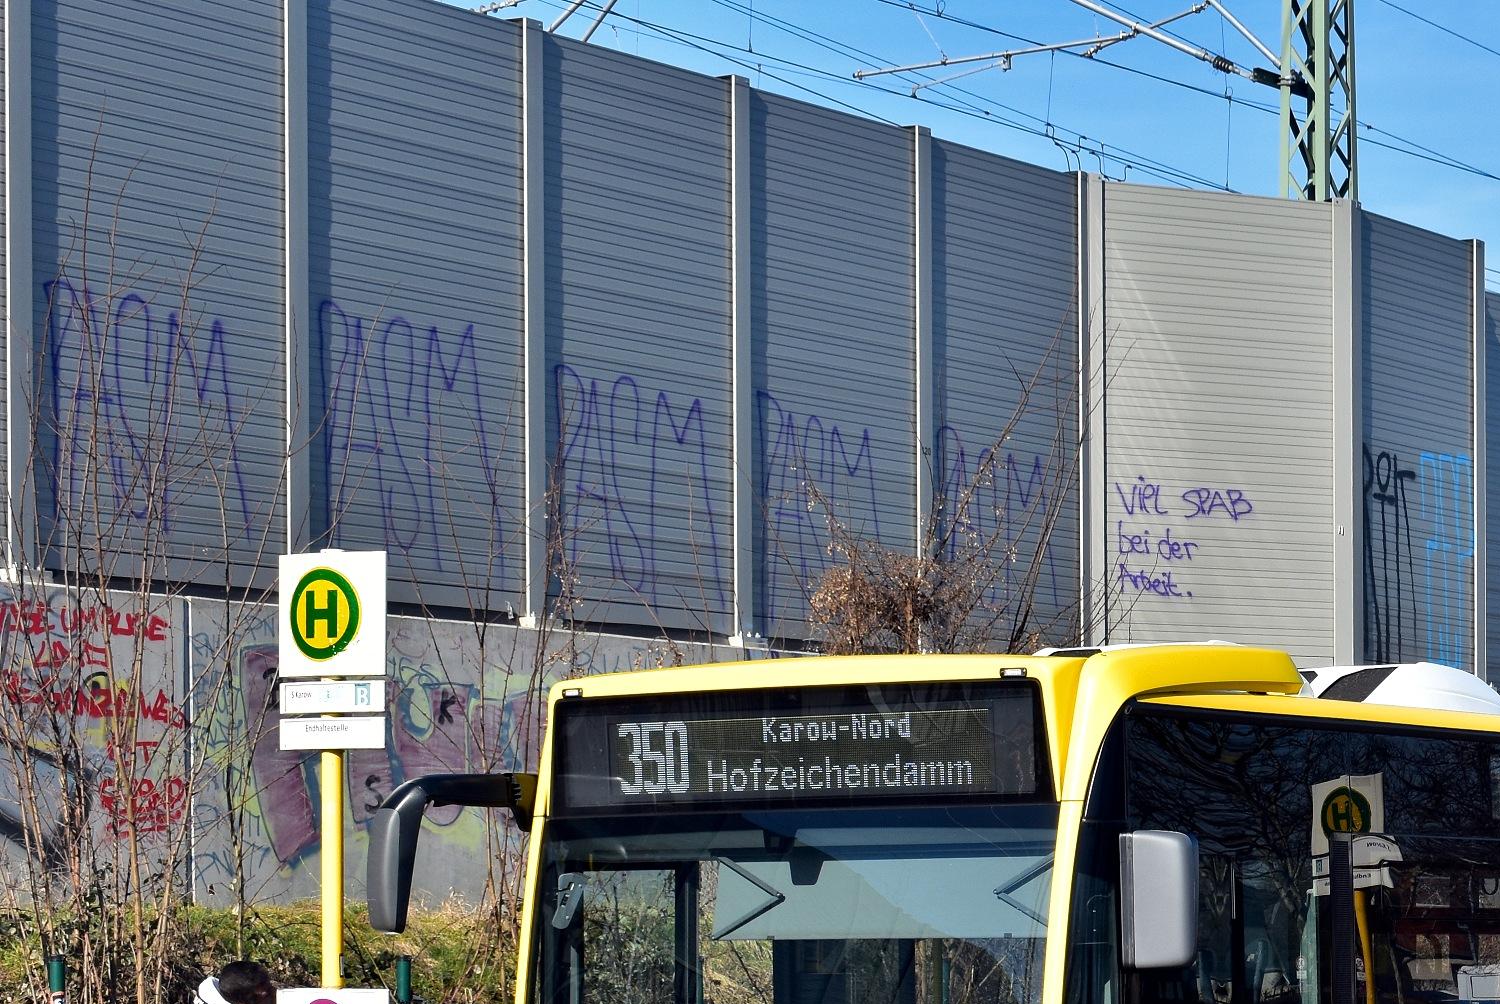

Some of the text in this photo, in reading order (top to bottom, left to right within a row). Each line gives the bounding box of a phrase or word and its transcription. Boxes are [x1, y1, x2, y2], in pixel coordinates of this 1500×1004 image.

[1118, 520, 1199, 561] bei der
[305, 589, 338, 639] H
[618, 712, 912, 795] 350 Karow-Nord
[707, 754, 974, 793] Hofzeichendamm
